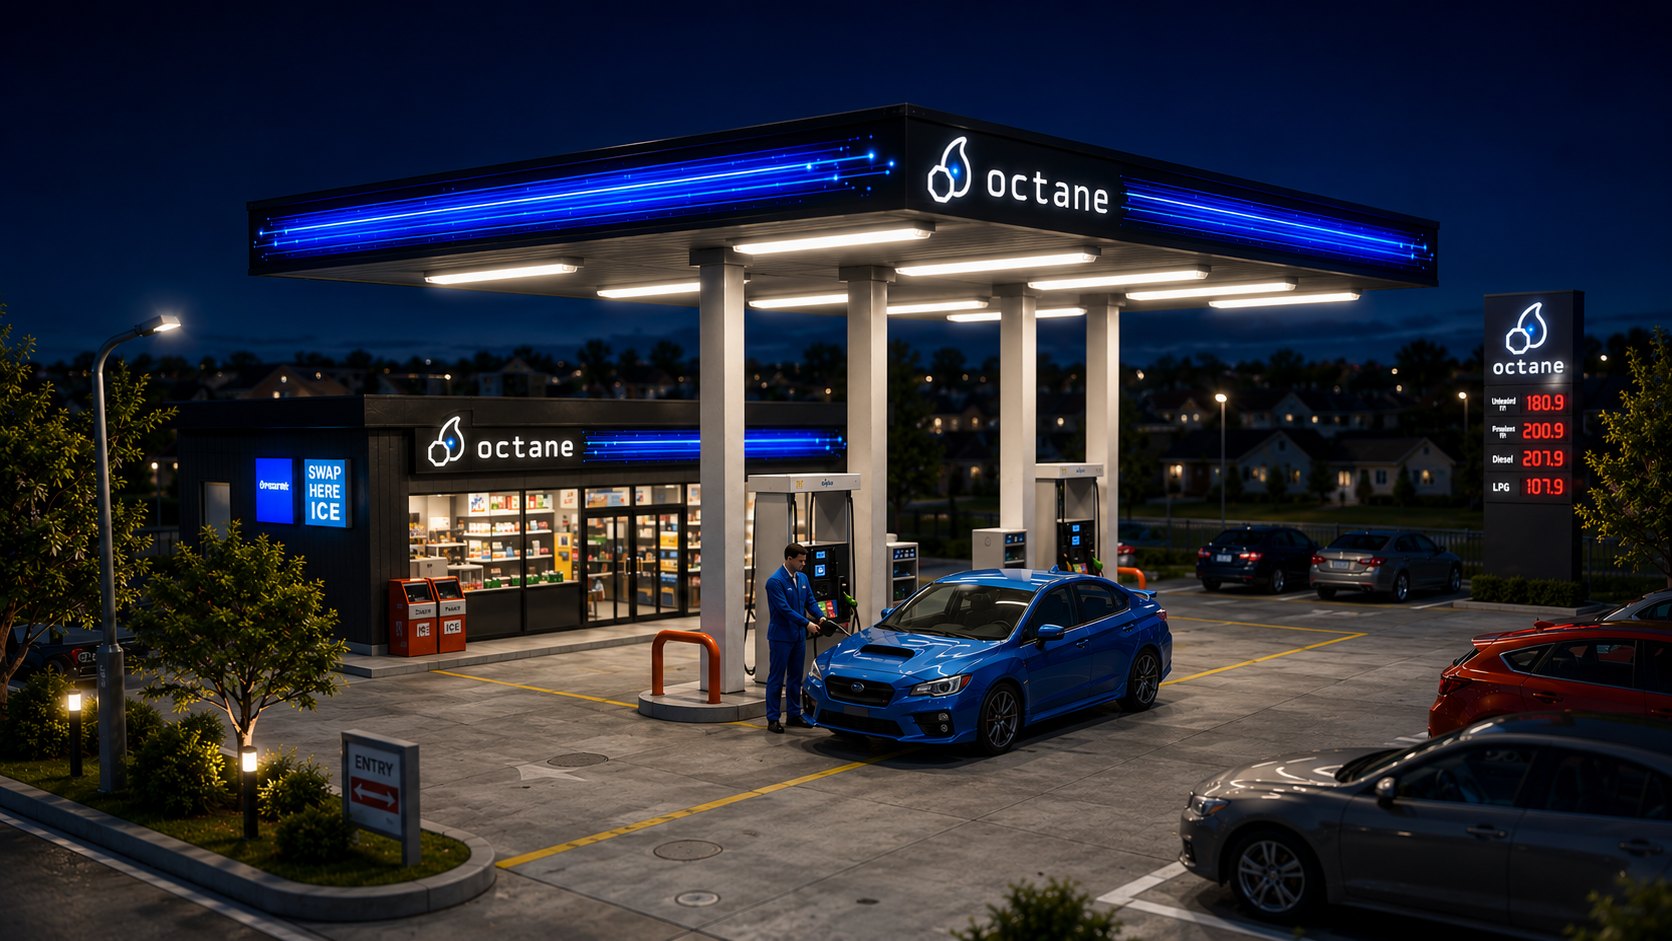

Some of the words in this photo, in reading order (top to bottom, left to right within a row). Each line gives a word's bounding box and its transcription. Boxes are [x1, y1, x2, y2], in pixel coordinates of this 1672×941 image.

[987, 169, 1109, 214] octane
[1493, 359, 1564, 375] octane
[1526, 393, 1565, 412] 180.9
[1522, 422, 1564, 439] 200.9
[477, 436, 574, 459] octane
[1492, 455, 1514, 464] Diesel
[1522, 450, 1564, 467] 207.9
[308, 465, 342, 480] SWAP
[309, 483, 341, 499] HERE
[1492, 482, 1510, 492] LPG
[1526, 478, 1564, 495] 107.9
[311, 501, 340, 521] ICE
[446, 622, 460, 632] ICE
[355, 754, 393, 776] ENTRY
